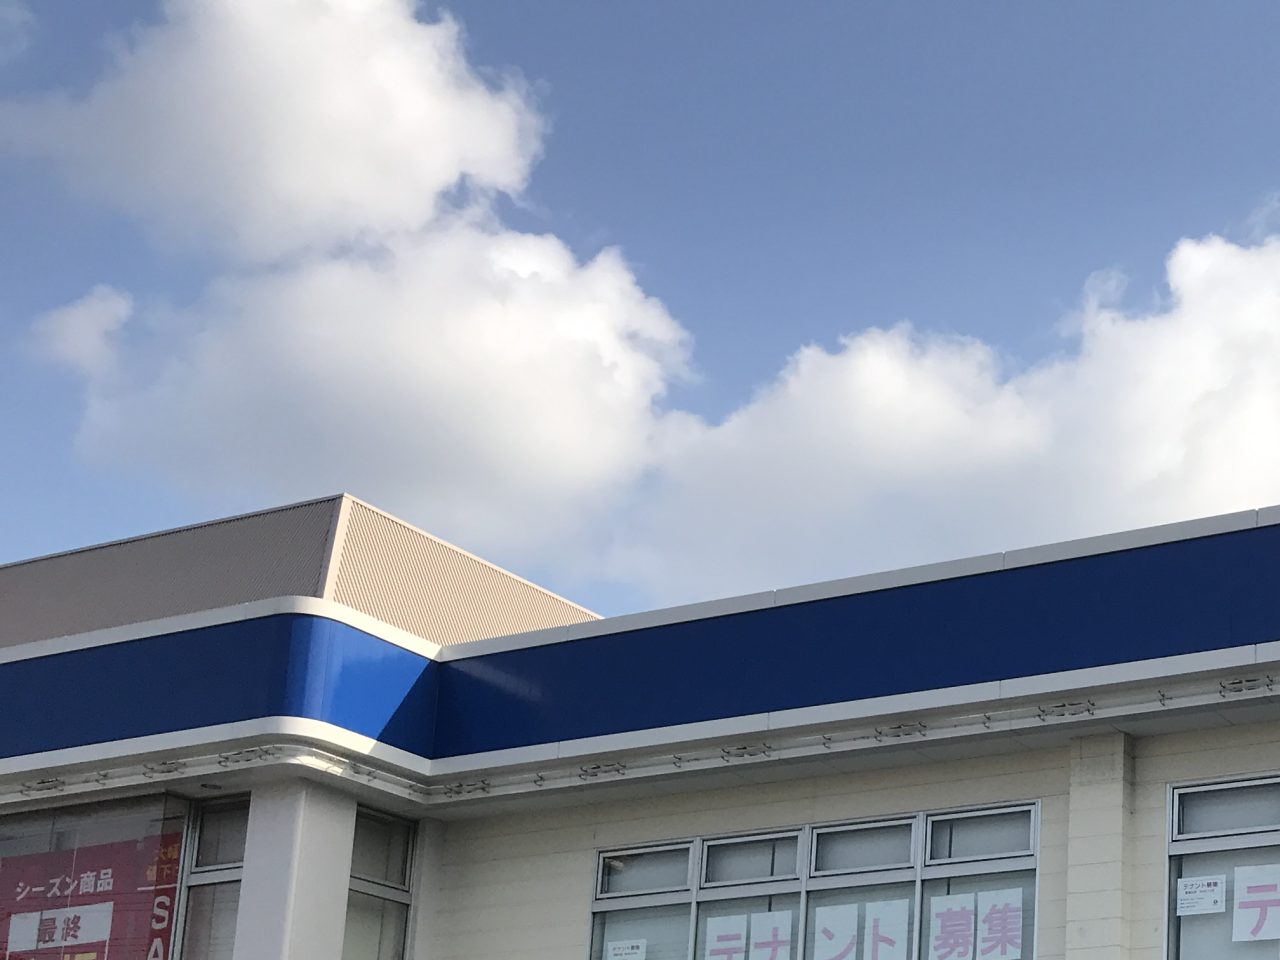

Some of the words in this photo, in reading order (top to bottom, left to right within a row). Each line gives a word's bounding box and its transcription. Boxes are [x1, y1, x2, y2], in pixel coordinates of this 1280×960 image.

[15, 867, 114, 901] シーズン商品
[37, 913, 82, 945] 最終
